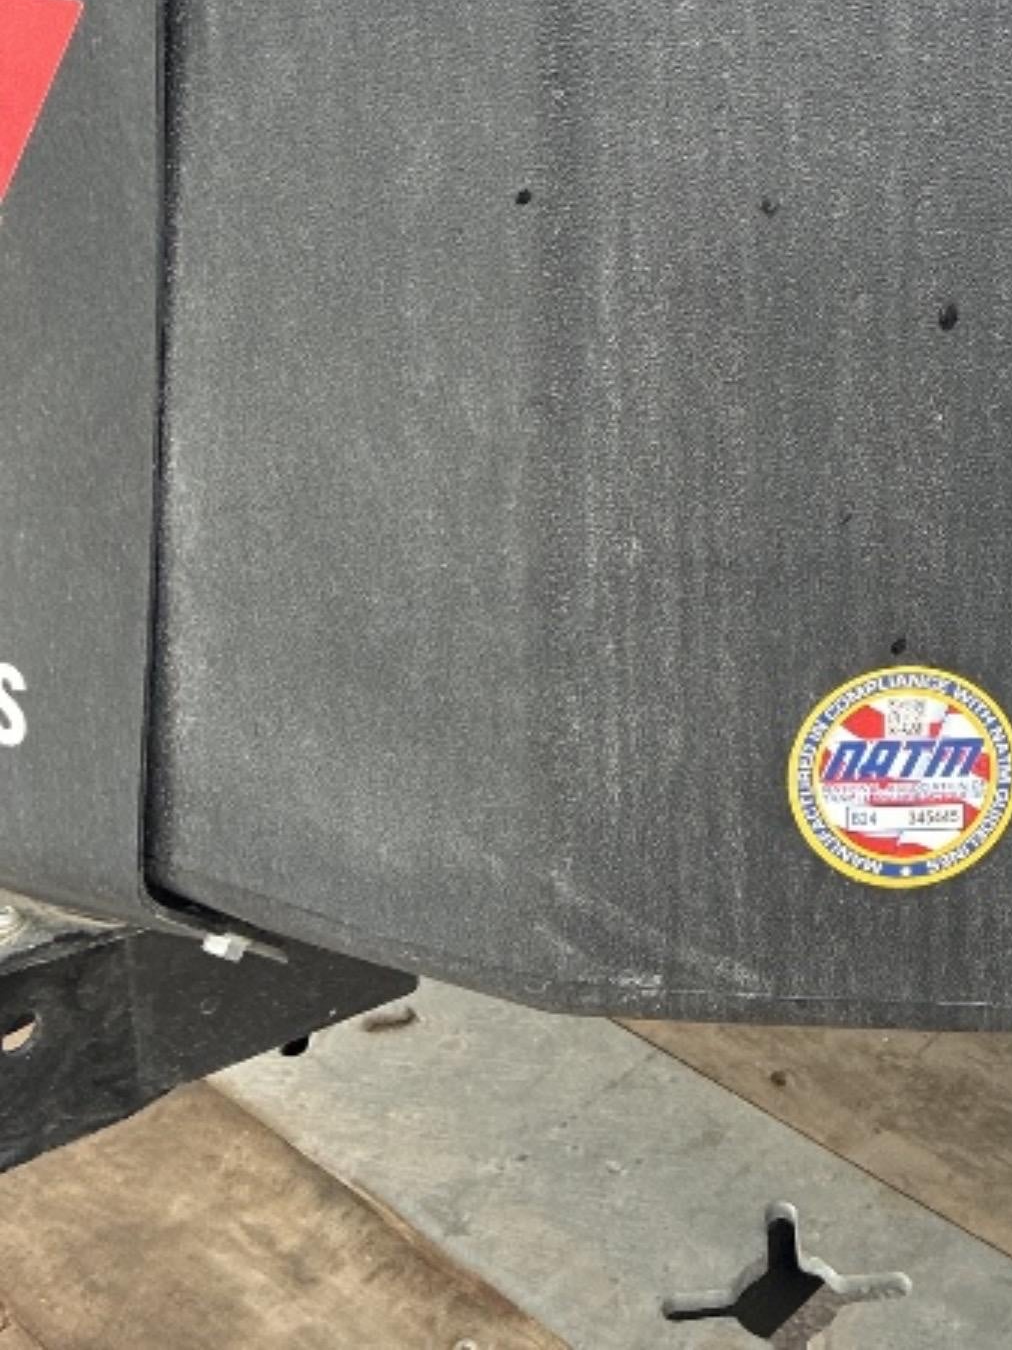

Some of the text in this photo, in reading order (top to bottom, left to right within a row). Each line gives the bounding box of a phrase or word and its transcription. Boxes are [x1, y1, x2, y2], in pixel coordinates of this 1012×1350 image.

[826, 673, 949, 720] COMPLIANCE
[953, 680, 993, 725] WITH
[822, 737, 985, 781] NATM
[993, 727, 1012, 784] NATM
[799, 743, 883, 875] MANUFACTURED
[926, 789, 1010, 873] GUIDELINES
